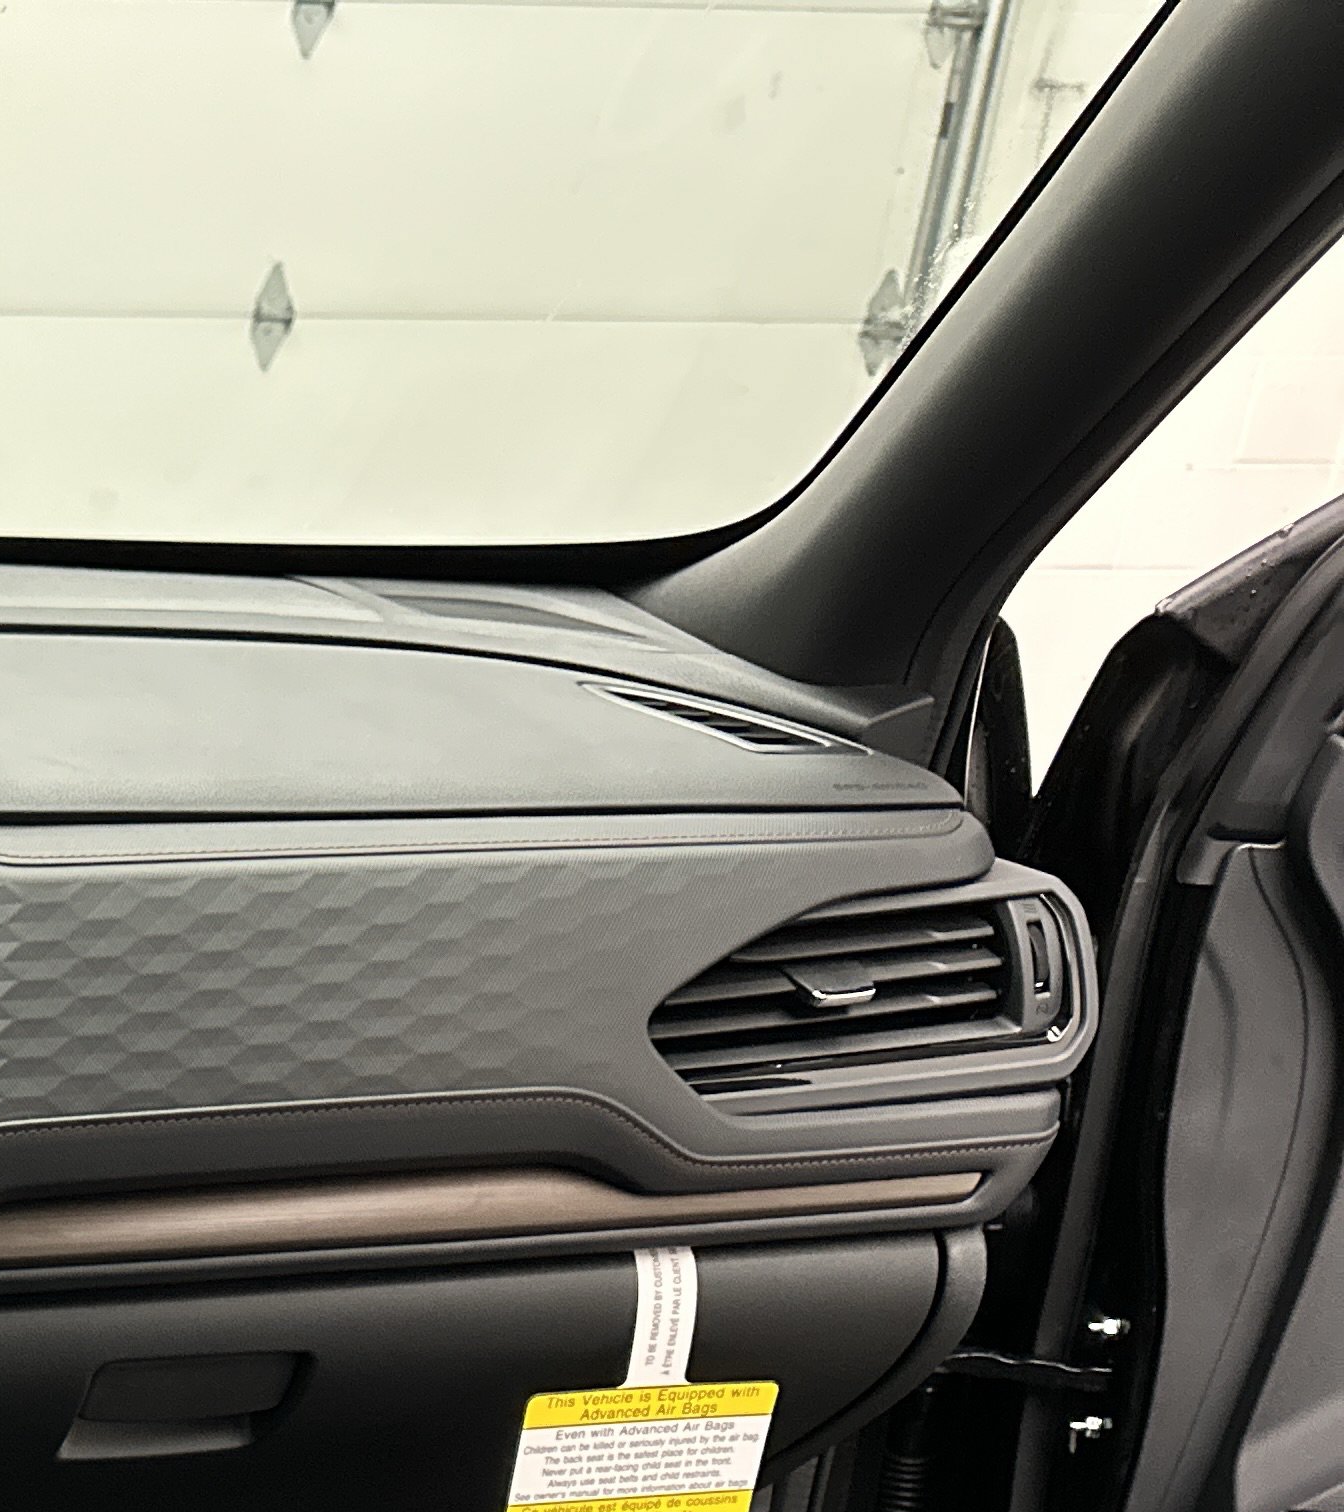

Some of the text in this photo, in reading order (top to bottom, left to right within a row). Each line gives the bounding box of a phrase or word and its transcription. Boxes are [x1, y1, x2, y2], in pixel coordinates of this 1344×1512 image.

[670, 1258, 682, 1285] CLIENT
[654, 1290, 662, 1300] BY
[650, 1303, 662, 1341] REMOVED
[645, 1355, 655, 1367] TO
[547, 1386, 760, 1409] This Vehicle is Equipped with
[580, 1402, 718, 1420] Advanced Air Bags
[555, 1421, 735, 1440] Even with Advanced Air Bags
[524, 1446, 557, 1455] Children
[579, 1443, 590, 1451] be
[629, 1438, 665, 1448] seriously
[668, 1436, 696, 1446] injured
[699, 1436, 709, 1444] by
[713, 1434, 726, 1442] the
[545, 1456, 560, 1464] The
[563, 1455, 582, 1464] back
[617, 1452, 630, 1460] the
[686, 1447, 698, 1456] for
[569, 1466, 583, 1476] put
[642, 1461, 662, 1470] child
[695, 1458, 708, 1466] the
[547, 1479, 577, 1488] Always
[642, 1473, 658, 1481] and
[660, 1472, 680, 1480] child
[688, 1482, 711, 1490] about
[598, 1502, 616, 1512] est
[622, 1499, 661, 1512] équipé
[666, 1497, 681, 1508] de
[686, 1496, 738, 1506] coussins
